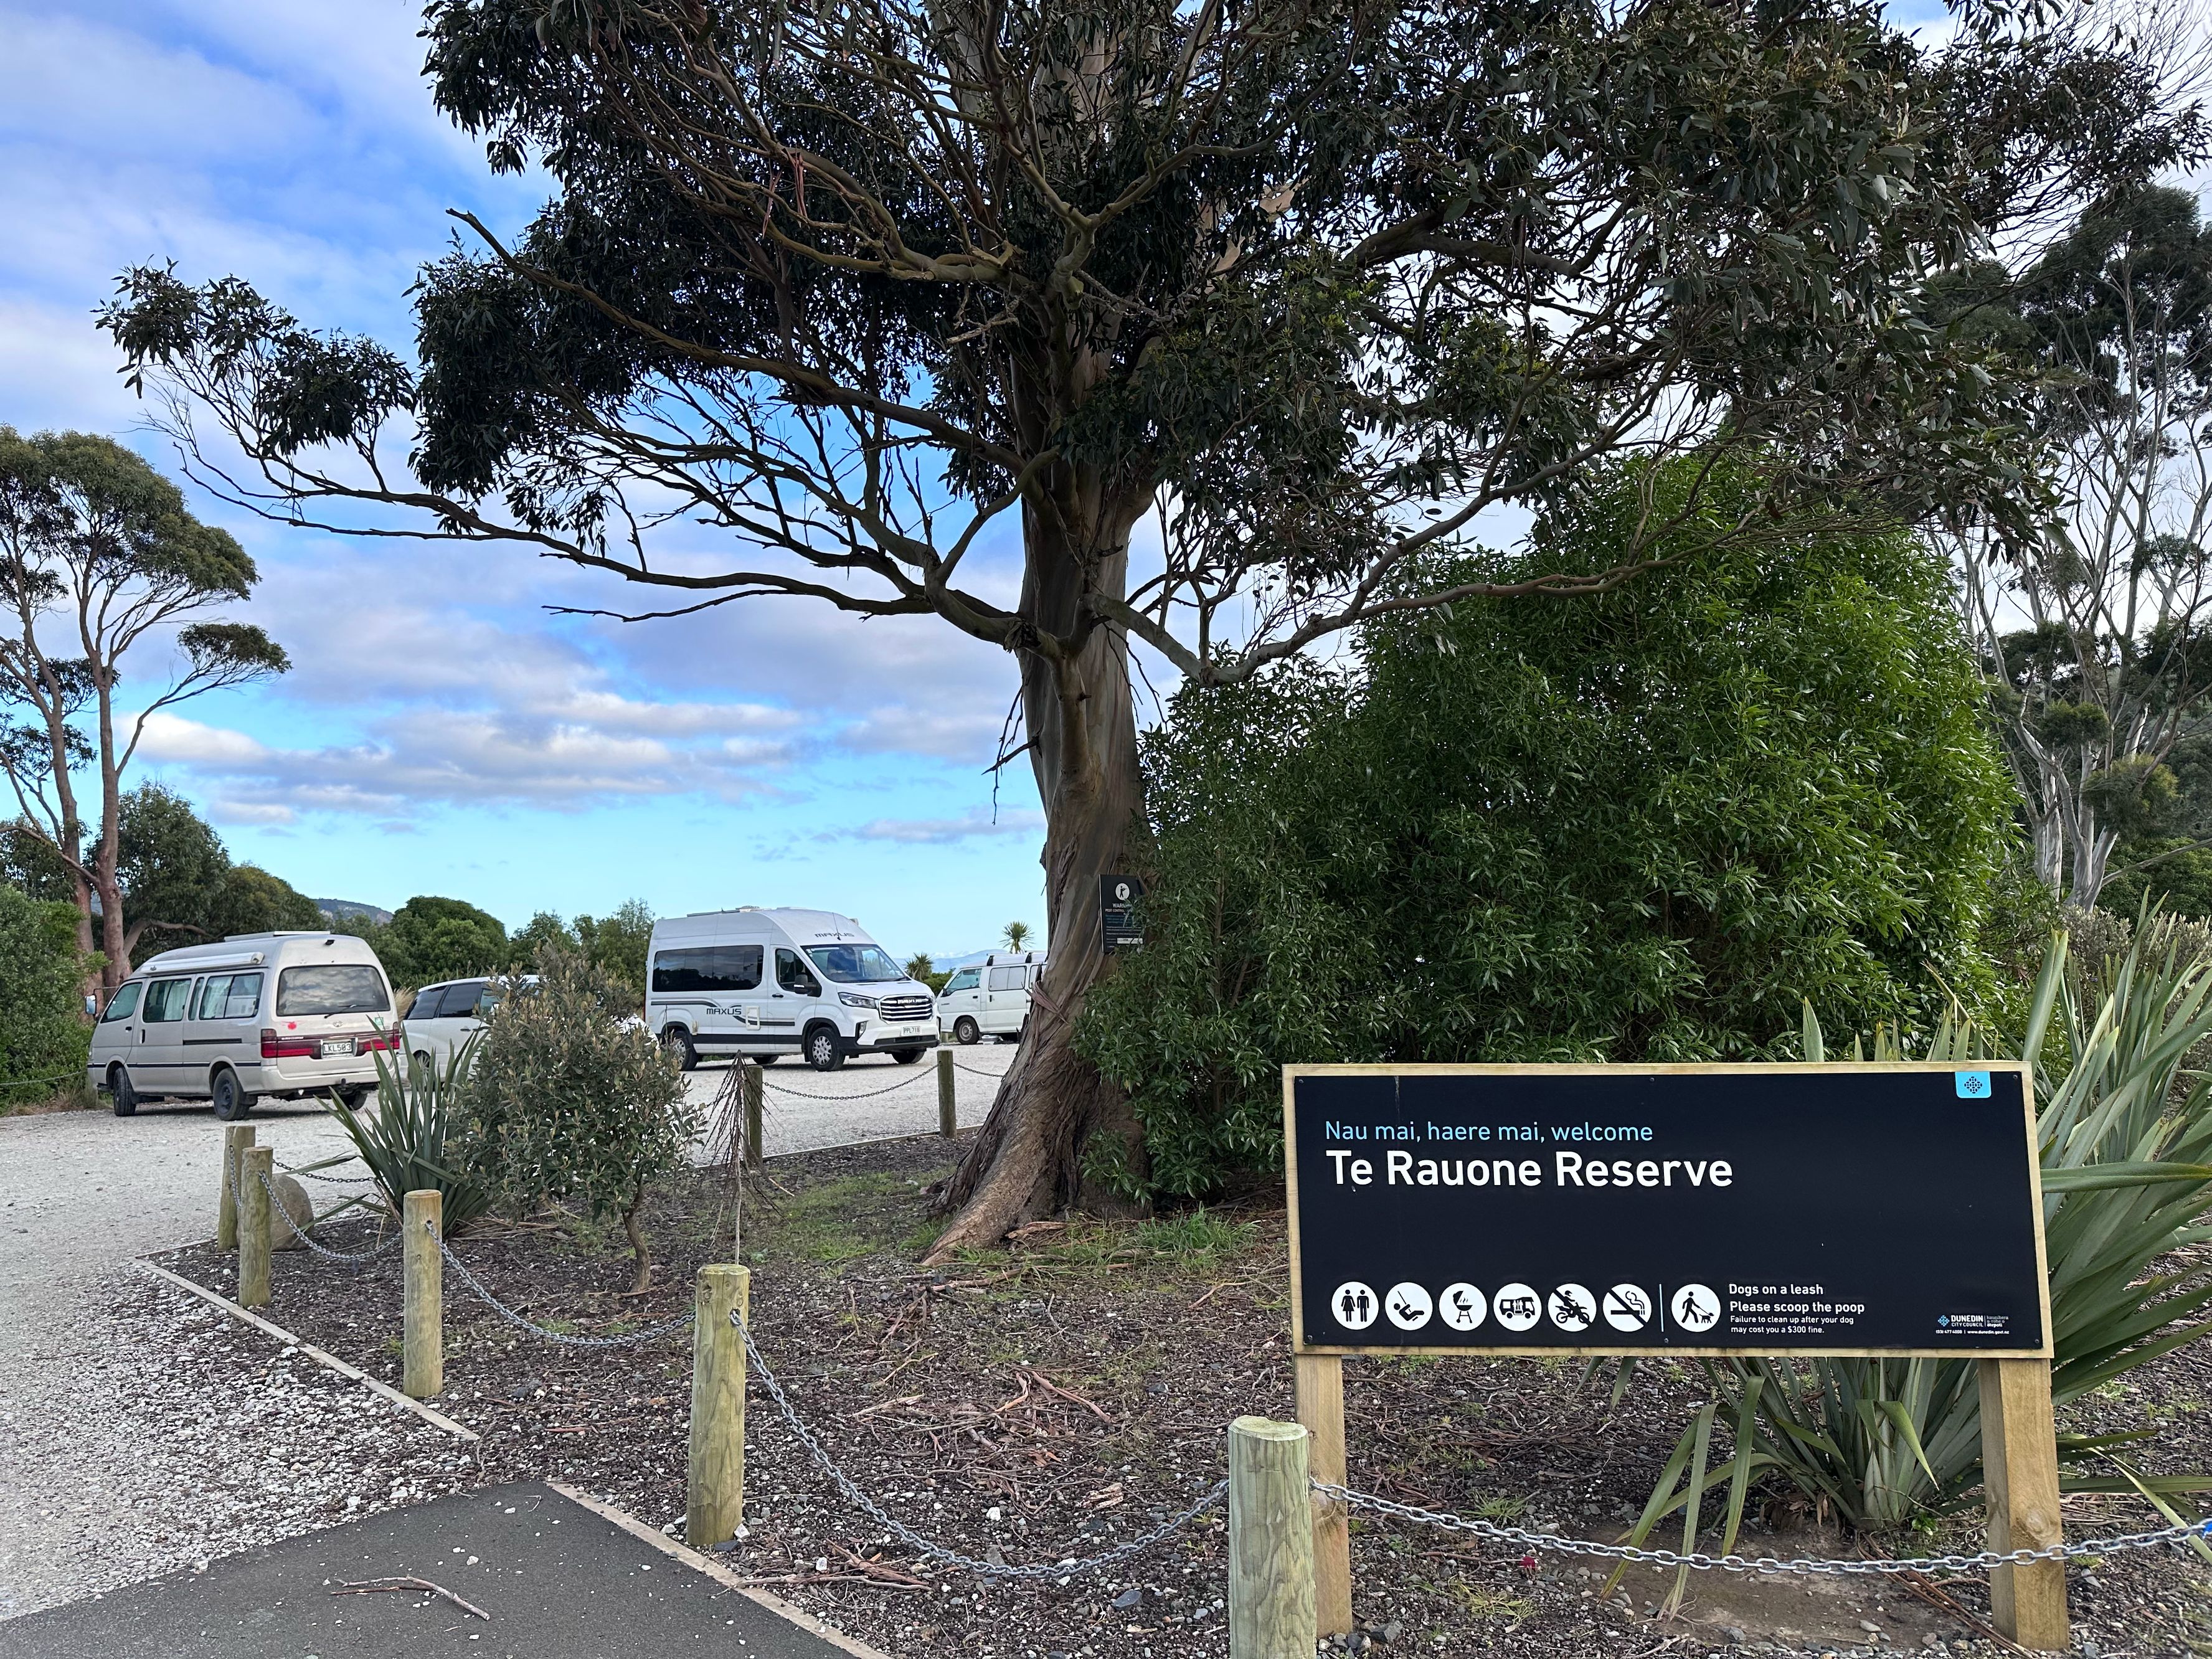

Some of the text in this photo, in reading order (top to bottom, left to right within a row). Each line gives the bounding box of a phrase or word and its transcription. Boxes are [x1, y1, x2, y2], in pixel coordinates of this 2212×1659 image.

[323, 1044, 351, 1052] LKL503
[1325, 1120, 1653, 1143] Nau mai, haere mai, welcome
[1325, 1150, 1733, 1187] Te Rauone Reserve
[1729, 1283, 1823, 1297] Dogs on a leash
[1729, 1301, 1865, 1315] Please scoop the poop
[1840, 1316, 1854, 1325] dog
[1787, 1325, 1807, 1333] $300
